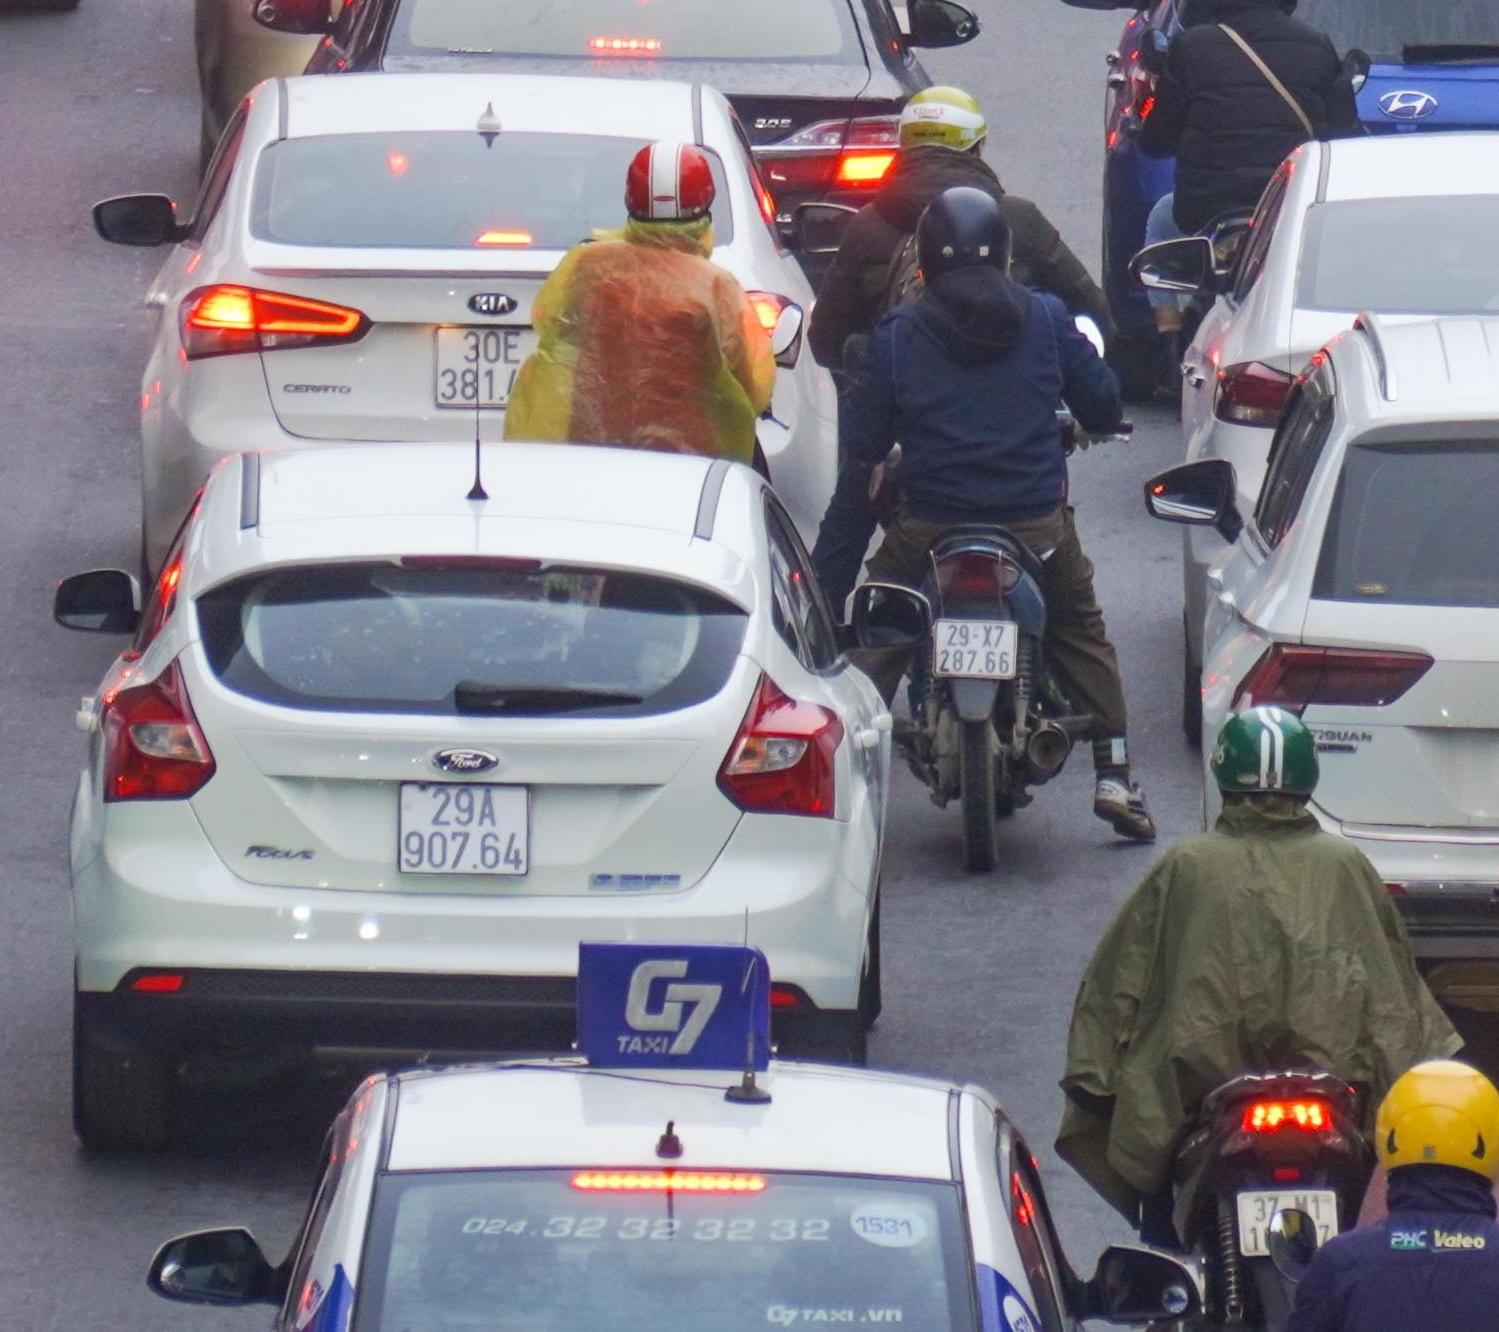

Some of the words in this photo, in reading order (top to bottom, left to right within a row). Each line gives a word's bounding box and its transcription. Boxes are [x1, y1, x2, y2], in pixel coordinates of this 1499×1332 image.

[474, 295, 510, 311] KIA
[463, 330, 521, 364] 30E
[283, 383, 352, 394] CERATO
[947, 624, 1005, 648] 29-X7
[939, 649, 1010, 674] 287.66
[431, 787, 496, 827] 29A
[404, 830, 522, 871] 907.64
[624, 959, 723, 1055] G7
[617, 1035, 670, 1054] TAXI
[618, 1218, 680, 1239] 32
[693, 1218, 756, 1239] 32
[770, 1218, 831, 1239] 32
[855, 1215, 914, 1237] 1531
[1434, 1229, 1486, 1248] Valeo
